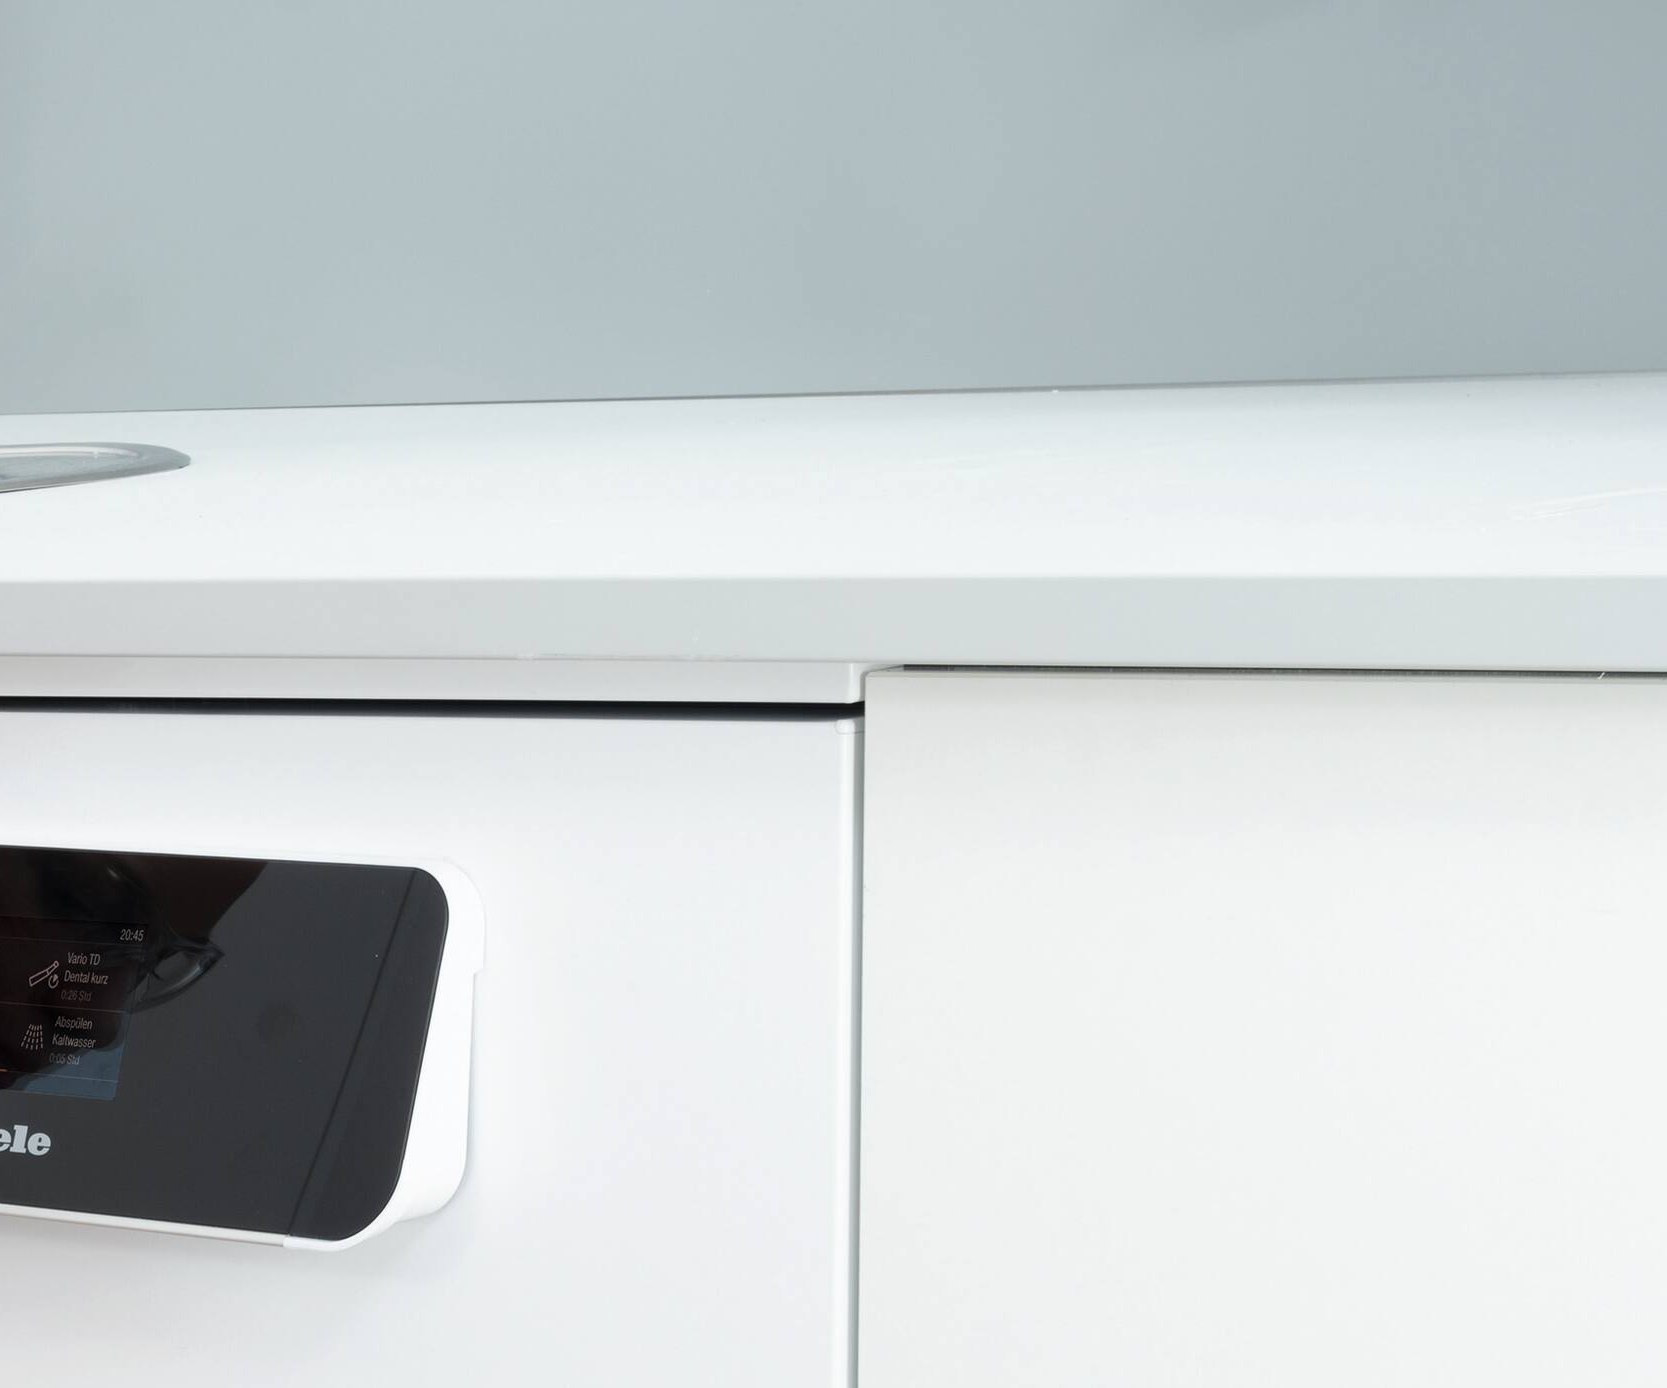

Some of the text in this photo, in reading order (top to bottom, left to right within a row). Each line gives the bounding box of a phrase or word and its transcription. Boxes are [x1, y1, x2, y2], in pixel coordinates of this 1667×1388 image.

[120, 929, 144, 942] 20:45
[67, 952, 101, 966] Vario TD
[64, 971, 109, 986] Dental kurz
[79, 991, 92, 1002] Std
[55, 1016, 93, 1031] Abspülen
[52, 1034, 96, 1048] Kaltwasser
[66, 1054, 80, 1065] Std
